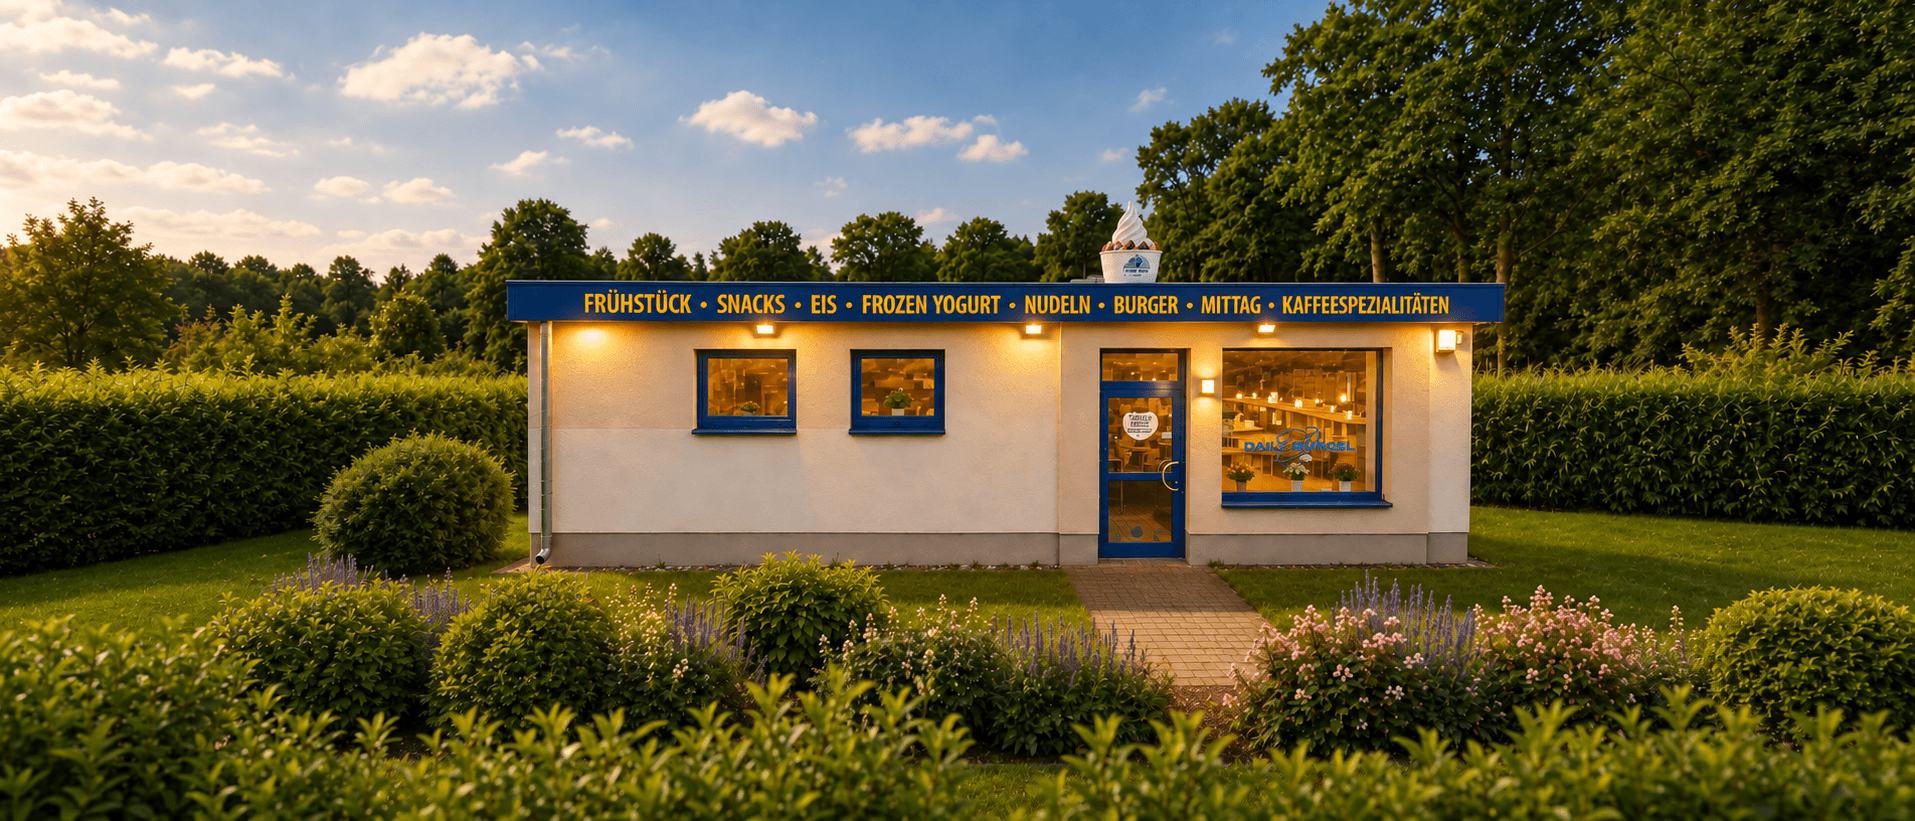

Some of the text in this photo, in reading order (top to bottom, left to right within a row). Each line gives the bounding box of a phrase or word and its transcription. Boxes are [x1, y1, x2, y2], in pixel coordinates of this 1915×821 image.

[584, 288, 1450, 315] FRÜHSTÜCK SNACKS EIS FROZEN YOGURT NUDELN BURGER MITTAG KAFFEESPEZIALITÄTEN
